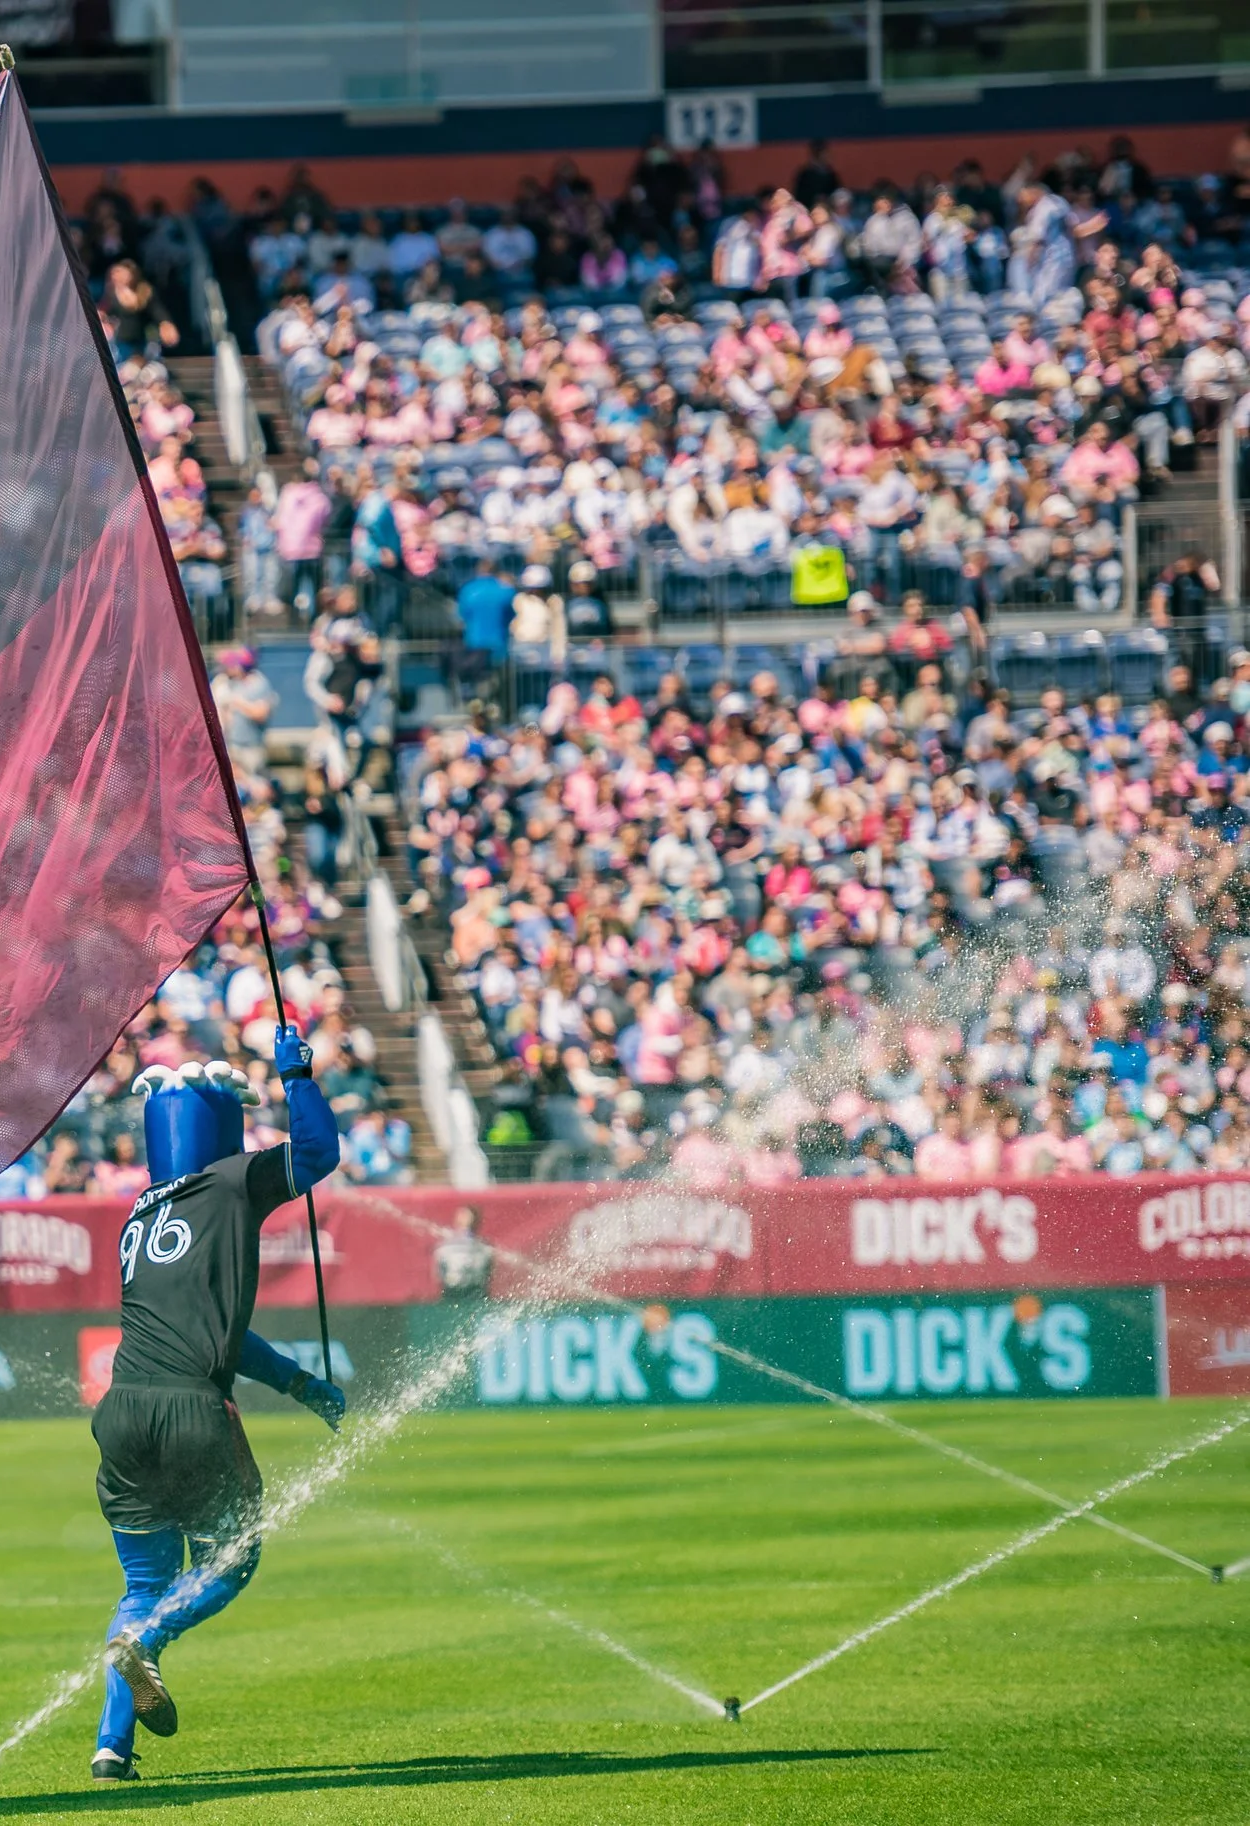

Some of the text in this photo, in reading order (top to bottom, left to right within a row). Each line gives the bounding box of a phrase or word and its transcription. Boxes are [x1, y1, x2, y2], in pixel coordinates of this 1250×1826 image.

[679, 101, 745, 140] 112
[120, 1199, 192, 1285] 96
[852, 1187, 1038, 1266] DICK'S
[479, 1304, 719, 1401] DICK'S
[843, 1295, 1092, 1395] DICK'S
